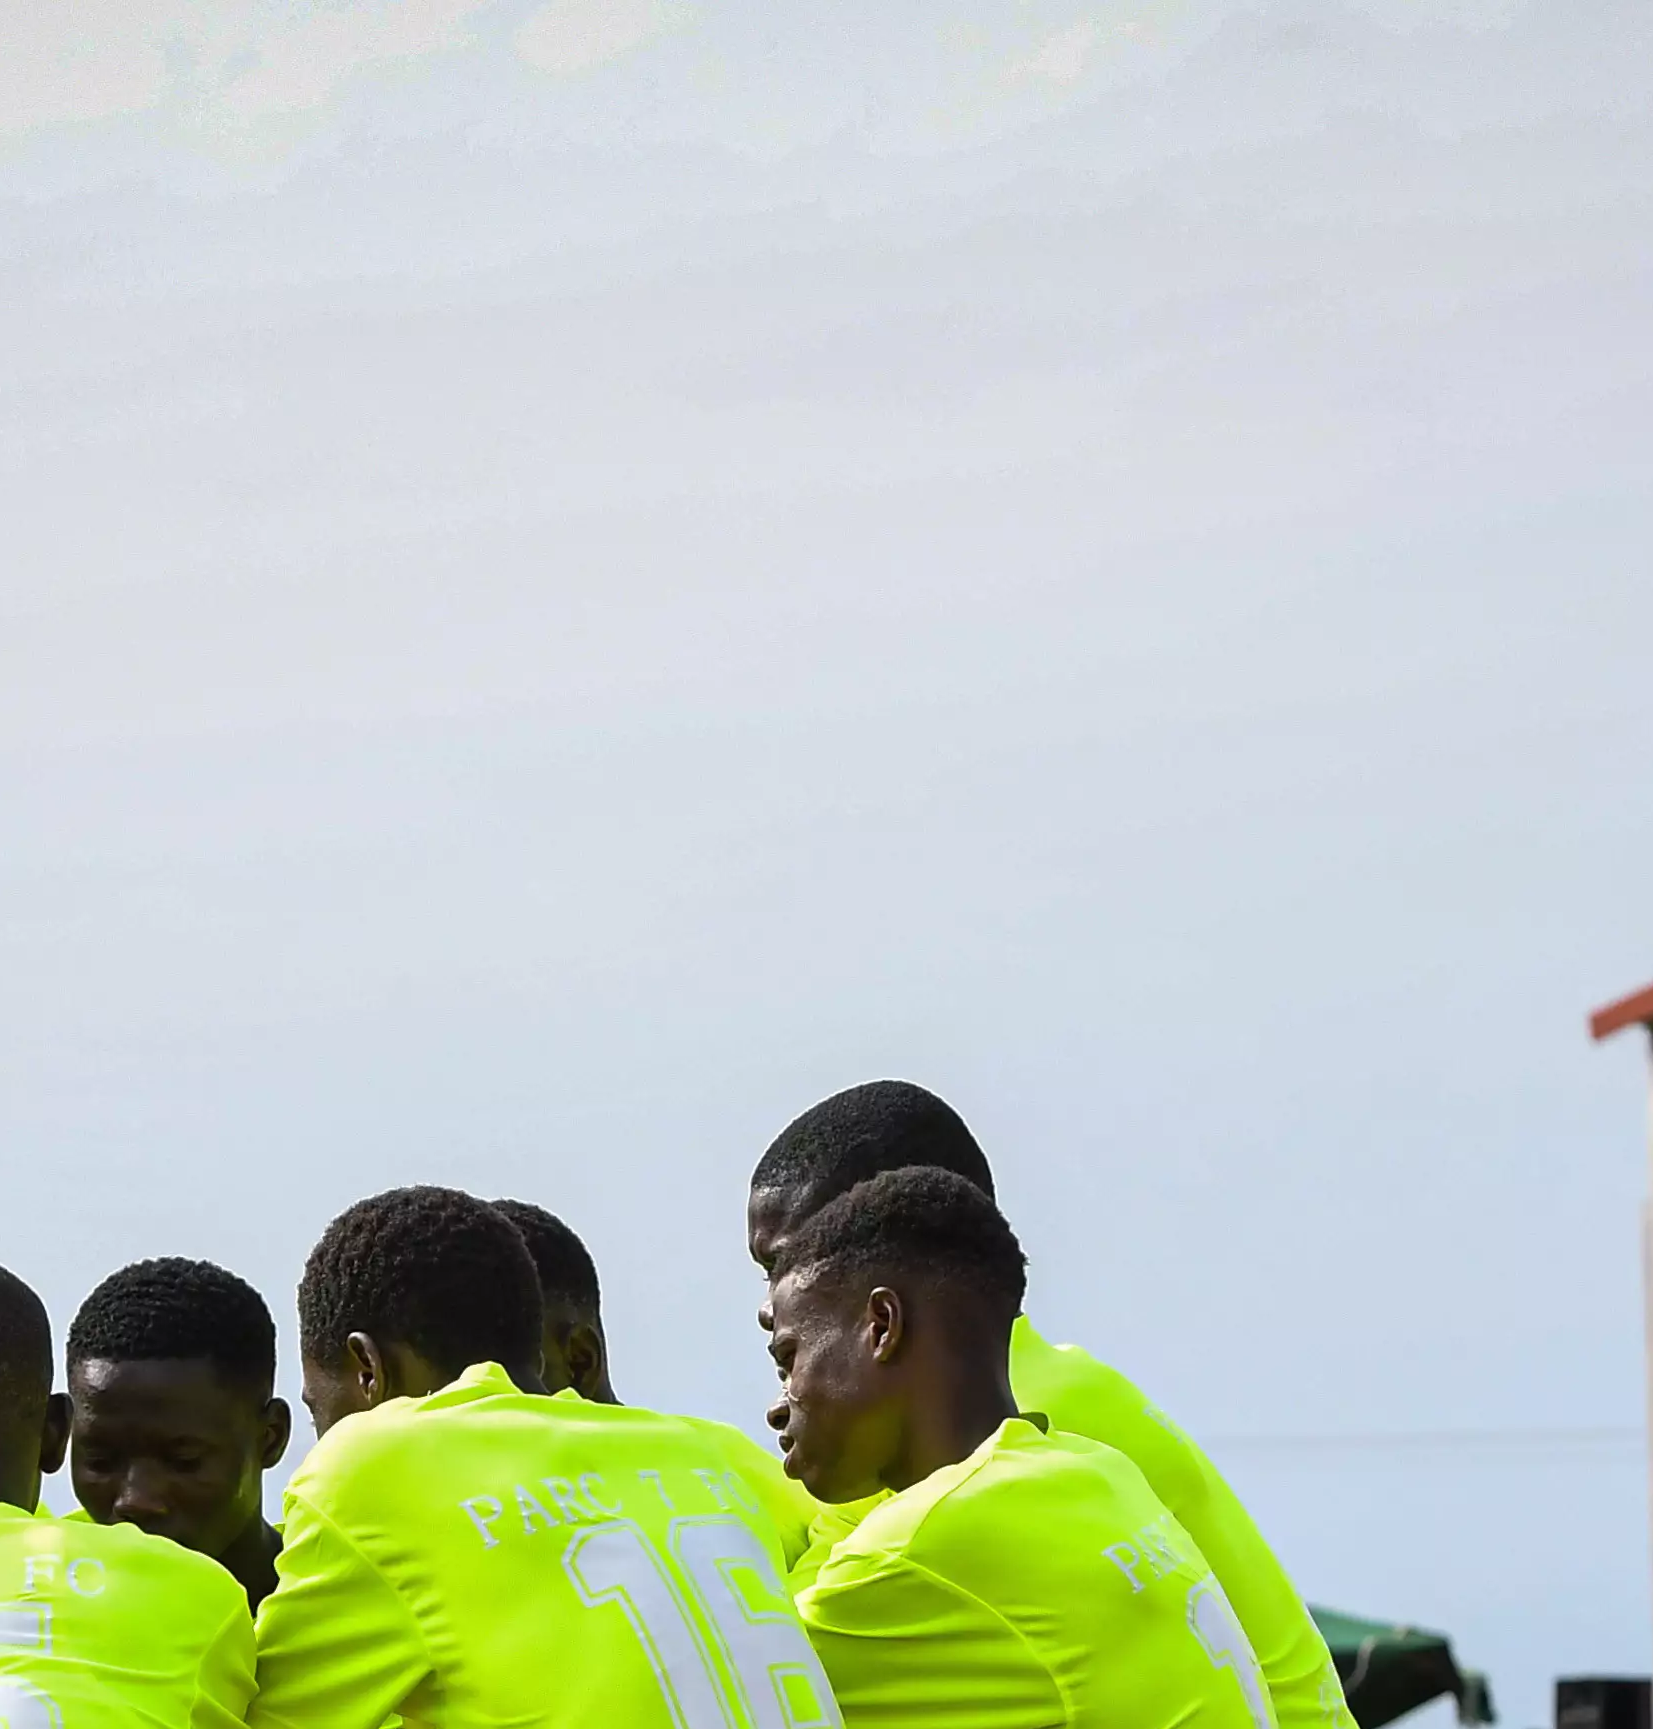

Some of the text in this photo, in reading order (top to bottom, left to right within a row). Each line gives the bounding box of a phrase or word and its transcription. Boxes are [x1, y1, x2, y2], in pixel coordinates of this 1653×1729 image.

[458, 1468, 759, 1549] PARC 7 FC
[23, 1554, 106, 1598] FC
